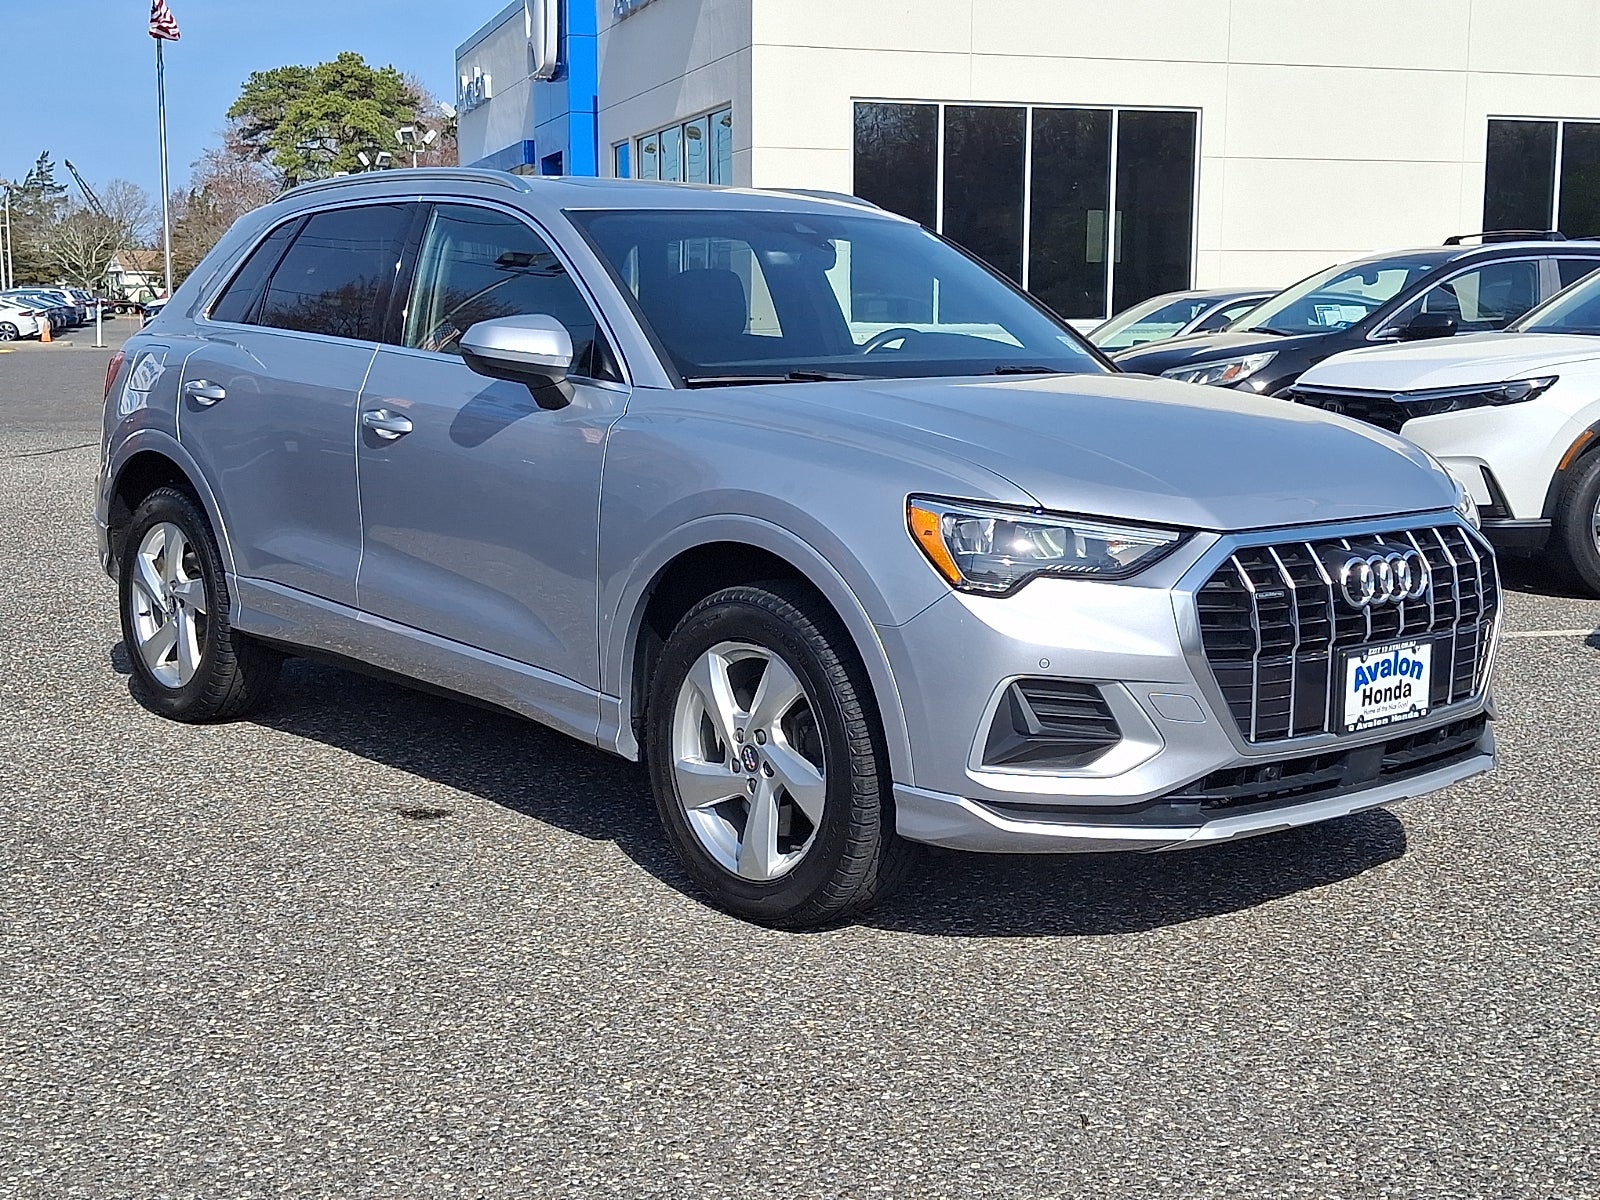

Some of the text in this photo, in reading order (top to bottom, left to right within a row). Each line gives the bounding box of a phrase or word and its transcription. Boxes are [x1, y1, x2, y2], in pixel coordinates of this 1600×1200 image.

[1354, 650, 1424, 693] Avalon
[1362, 679, 1411, 707] Honda
[1356, 710, 1419, 730] Avalon Honda
